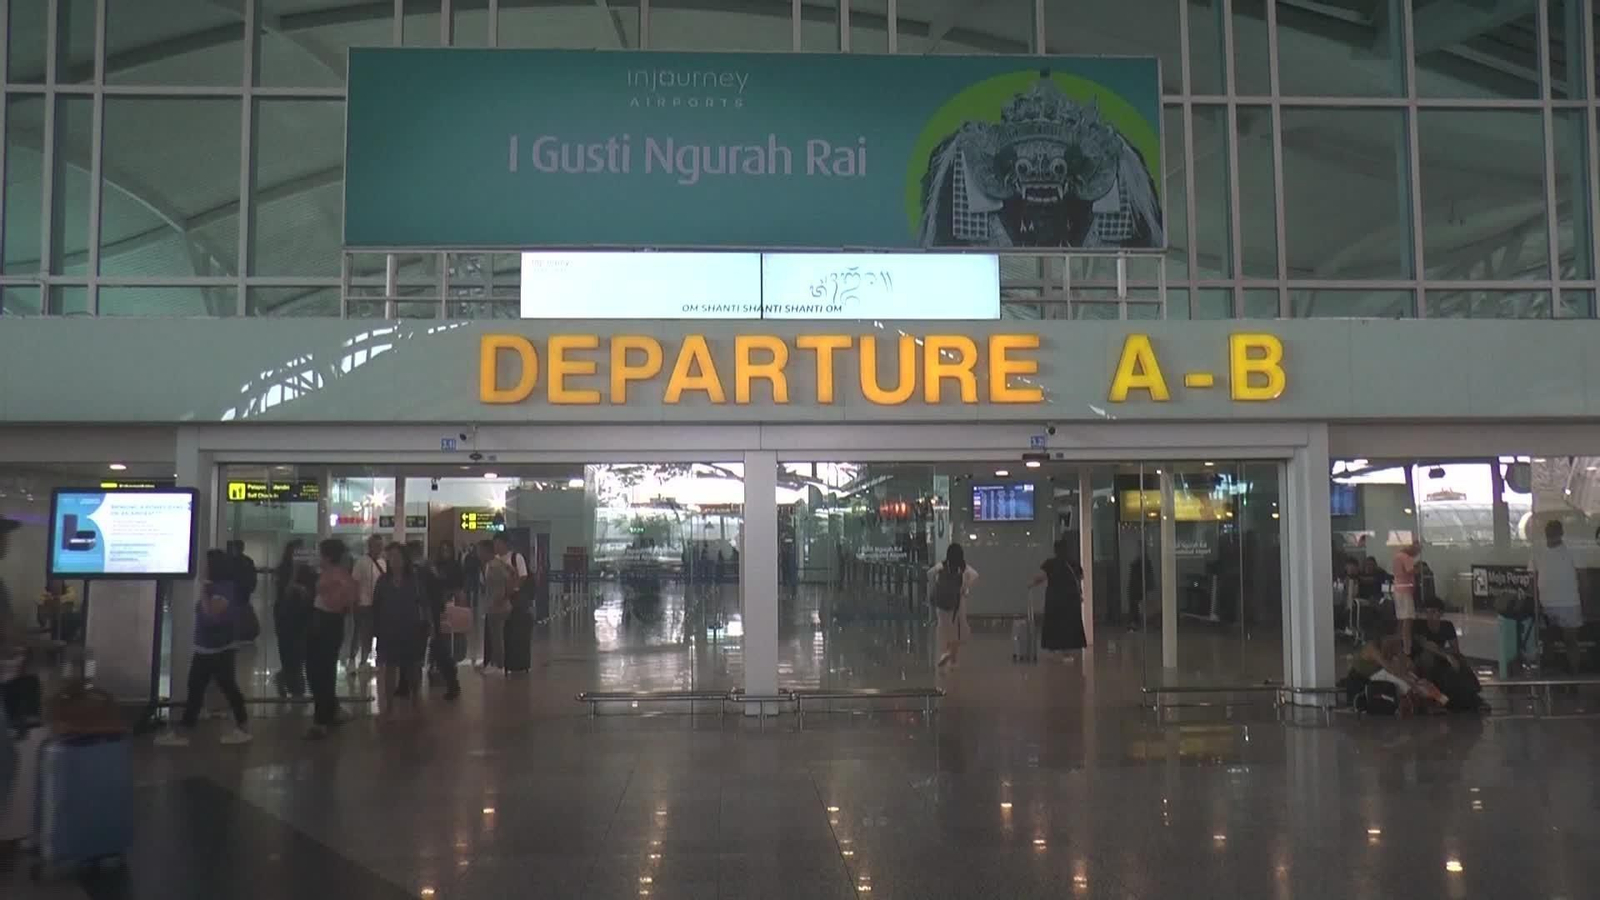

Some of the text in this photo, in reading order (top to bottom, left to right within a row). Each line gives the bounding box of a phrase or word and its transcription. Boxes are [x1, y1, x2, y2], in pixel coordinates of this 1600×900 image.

[630, 97, 745, 108] AIRPORTS
[509, 133, 867, 185] I Gusti Ngurah Rai
[682, 304, 843, 313] OM SHANTI SHANTI SHANTI OM
[479, 334, 1045, 405] DEPARTURE
[1111, 334, 1169, 402] A
[1230, 333, 1286, 401] B
